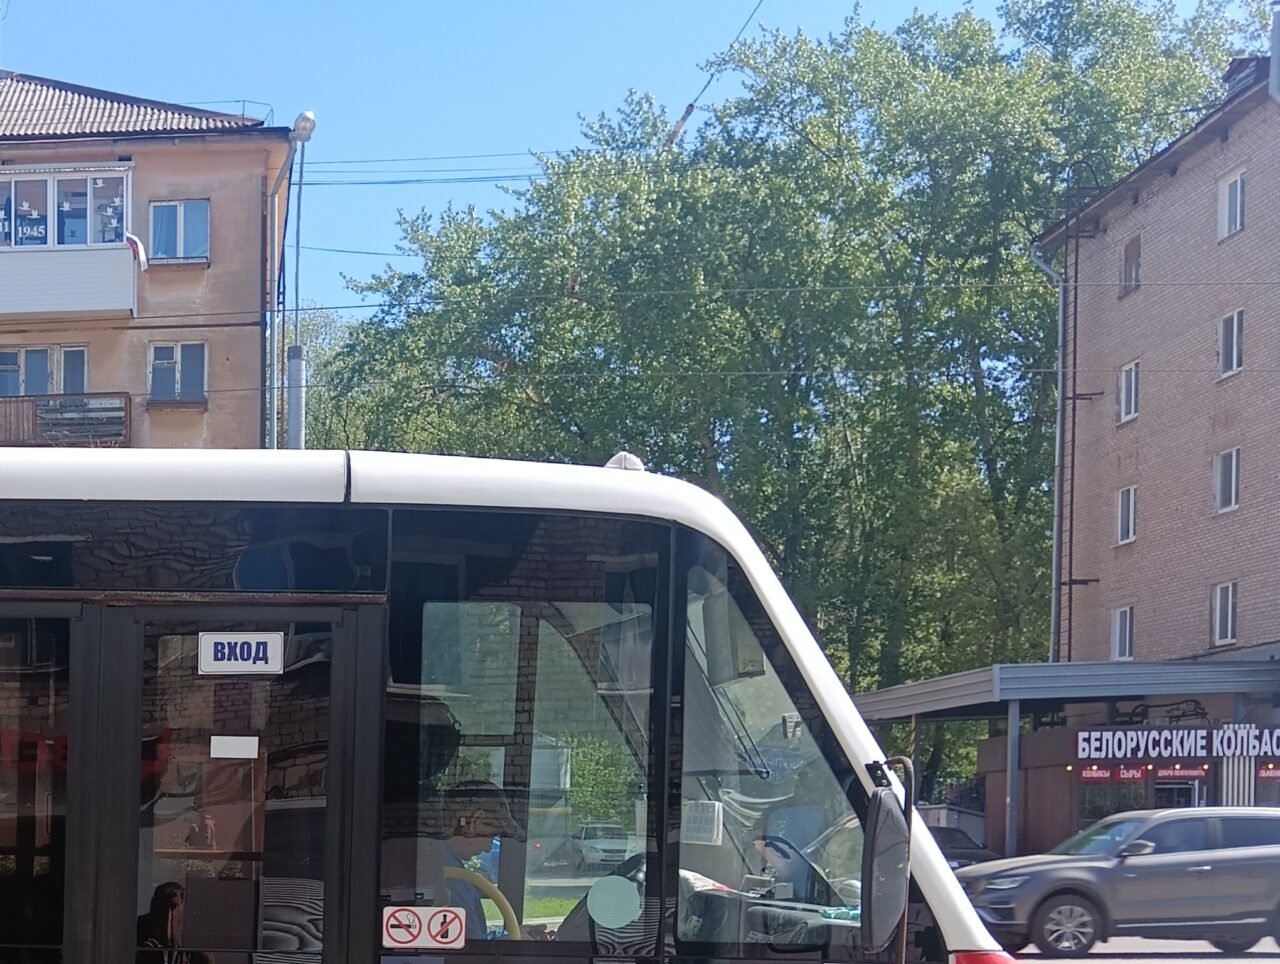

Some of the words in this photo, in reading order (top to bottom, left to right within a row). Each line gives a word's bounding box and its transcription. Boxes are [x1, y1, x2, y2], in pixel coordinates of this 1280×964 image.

[17, 225, 45, 238] 1945
[213, 641, 268, 665] ВХОД
[1077, 730, 1207, 759] БЕЛОРУССКИЕ
